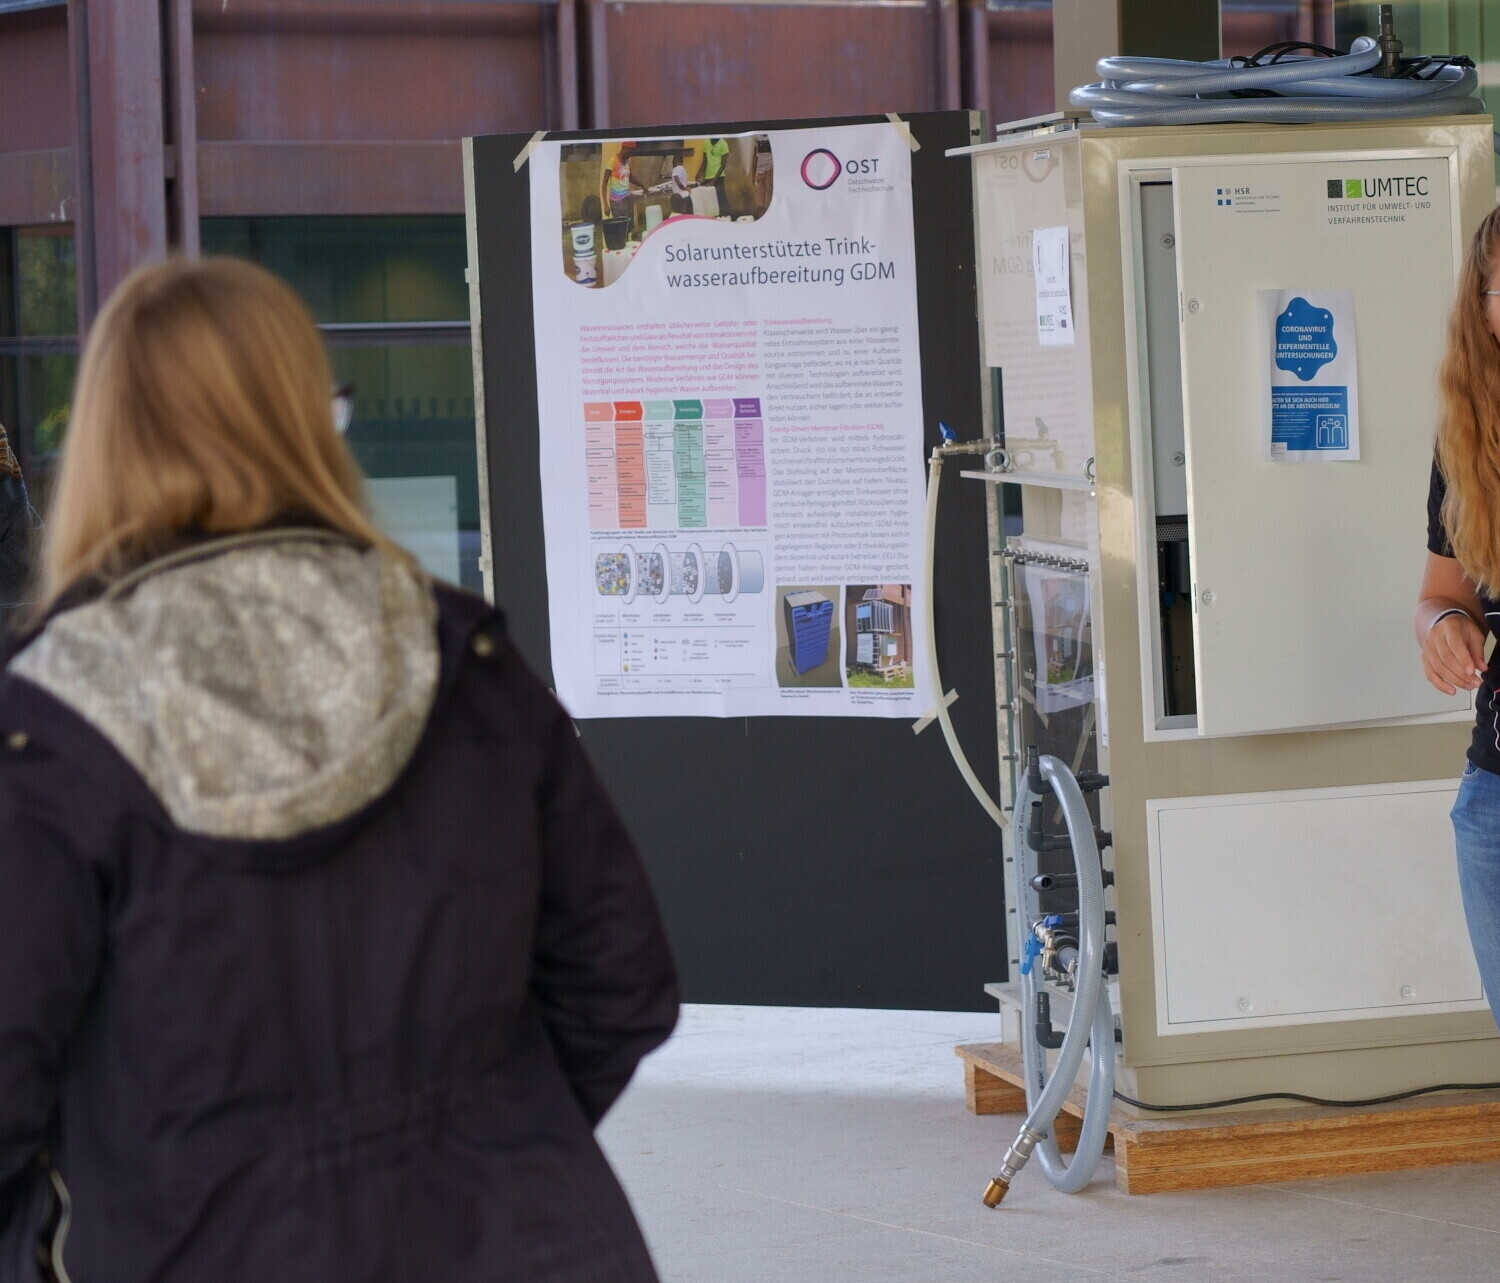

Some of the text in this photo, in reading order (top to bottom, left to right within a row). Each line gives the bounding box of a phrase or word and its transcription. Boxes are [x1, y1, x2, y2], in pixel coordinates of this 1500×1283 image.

[845, 158, 879, 174] OST
[1234, 187, 1250, 195] HSR
[1364, 176, 1429, 197] UMTEC
[1327, 201, 1431, 212] INSTITUT FÜR UMWELT- UND
[1328, 215, 1406, 225] VERFAHRENSTECHNIK
[664, 236, 876, 263] Solarunterstützte Trink-
[667, 261, 896, 288] wasseraufbereitung GDM
[1281, 325, 1327, 333] CORONAVIRUS
[1298, 334, 1313, 342] UND
